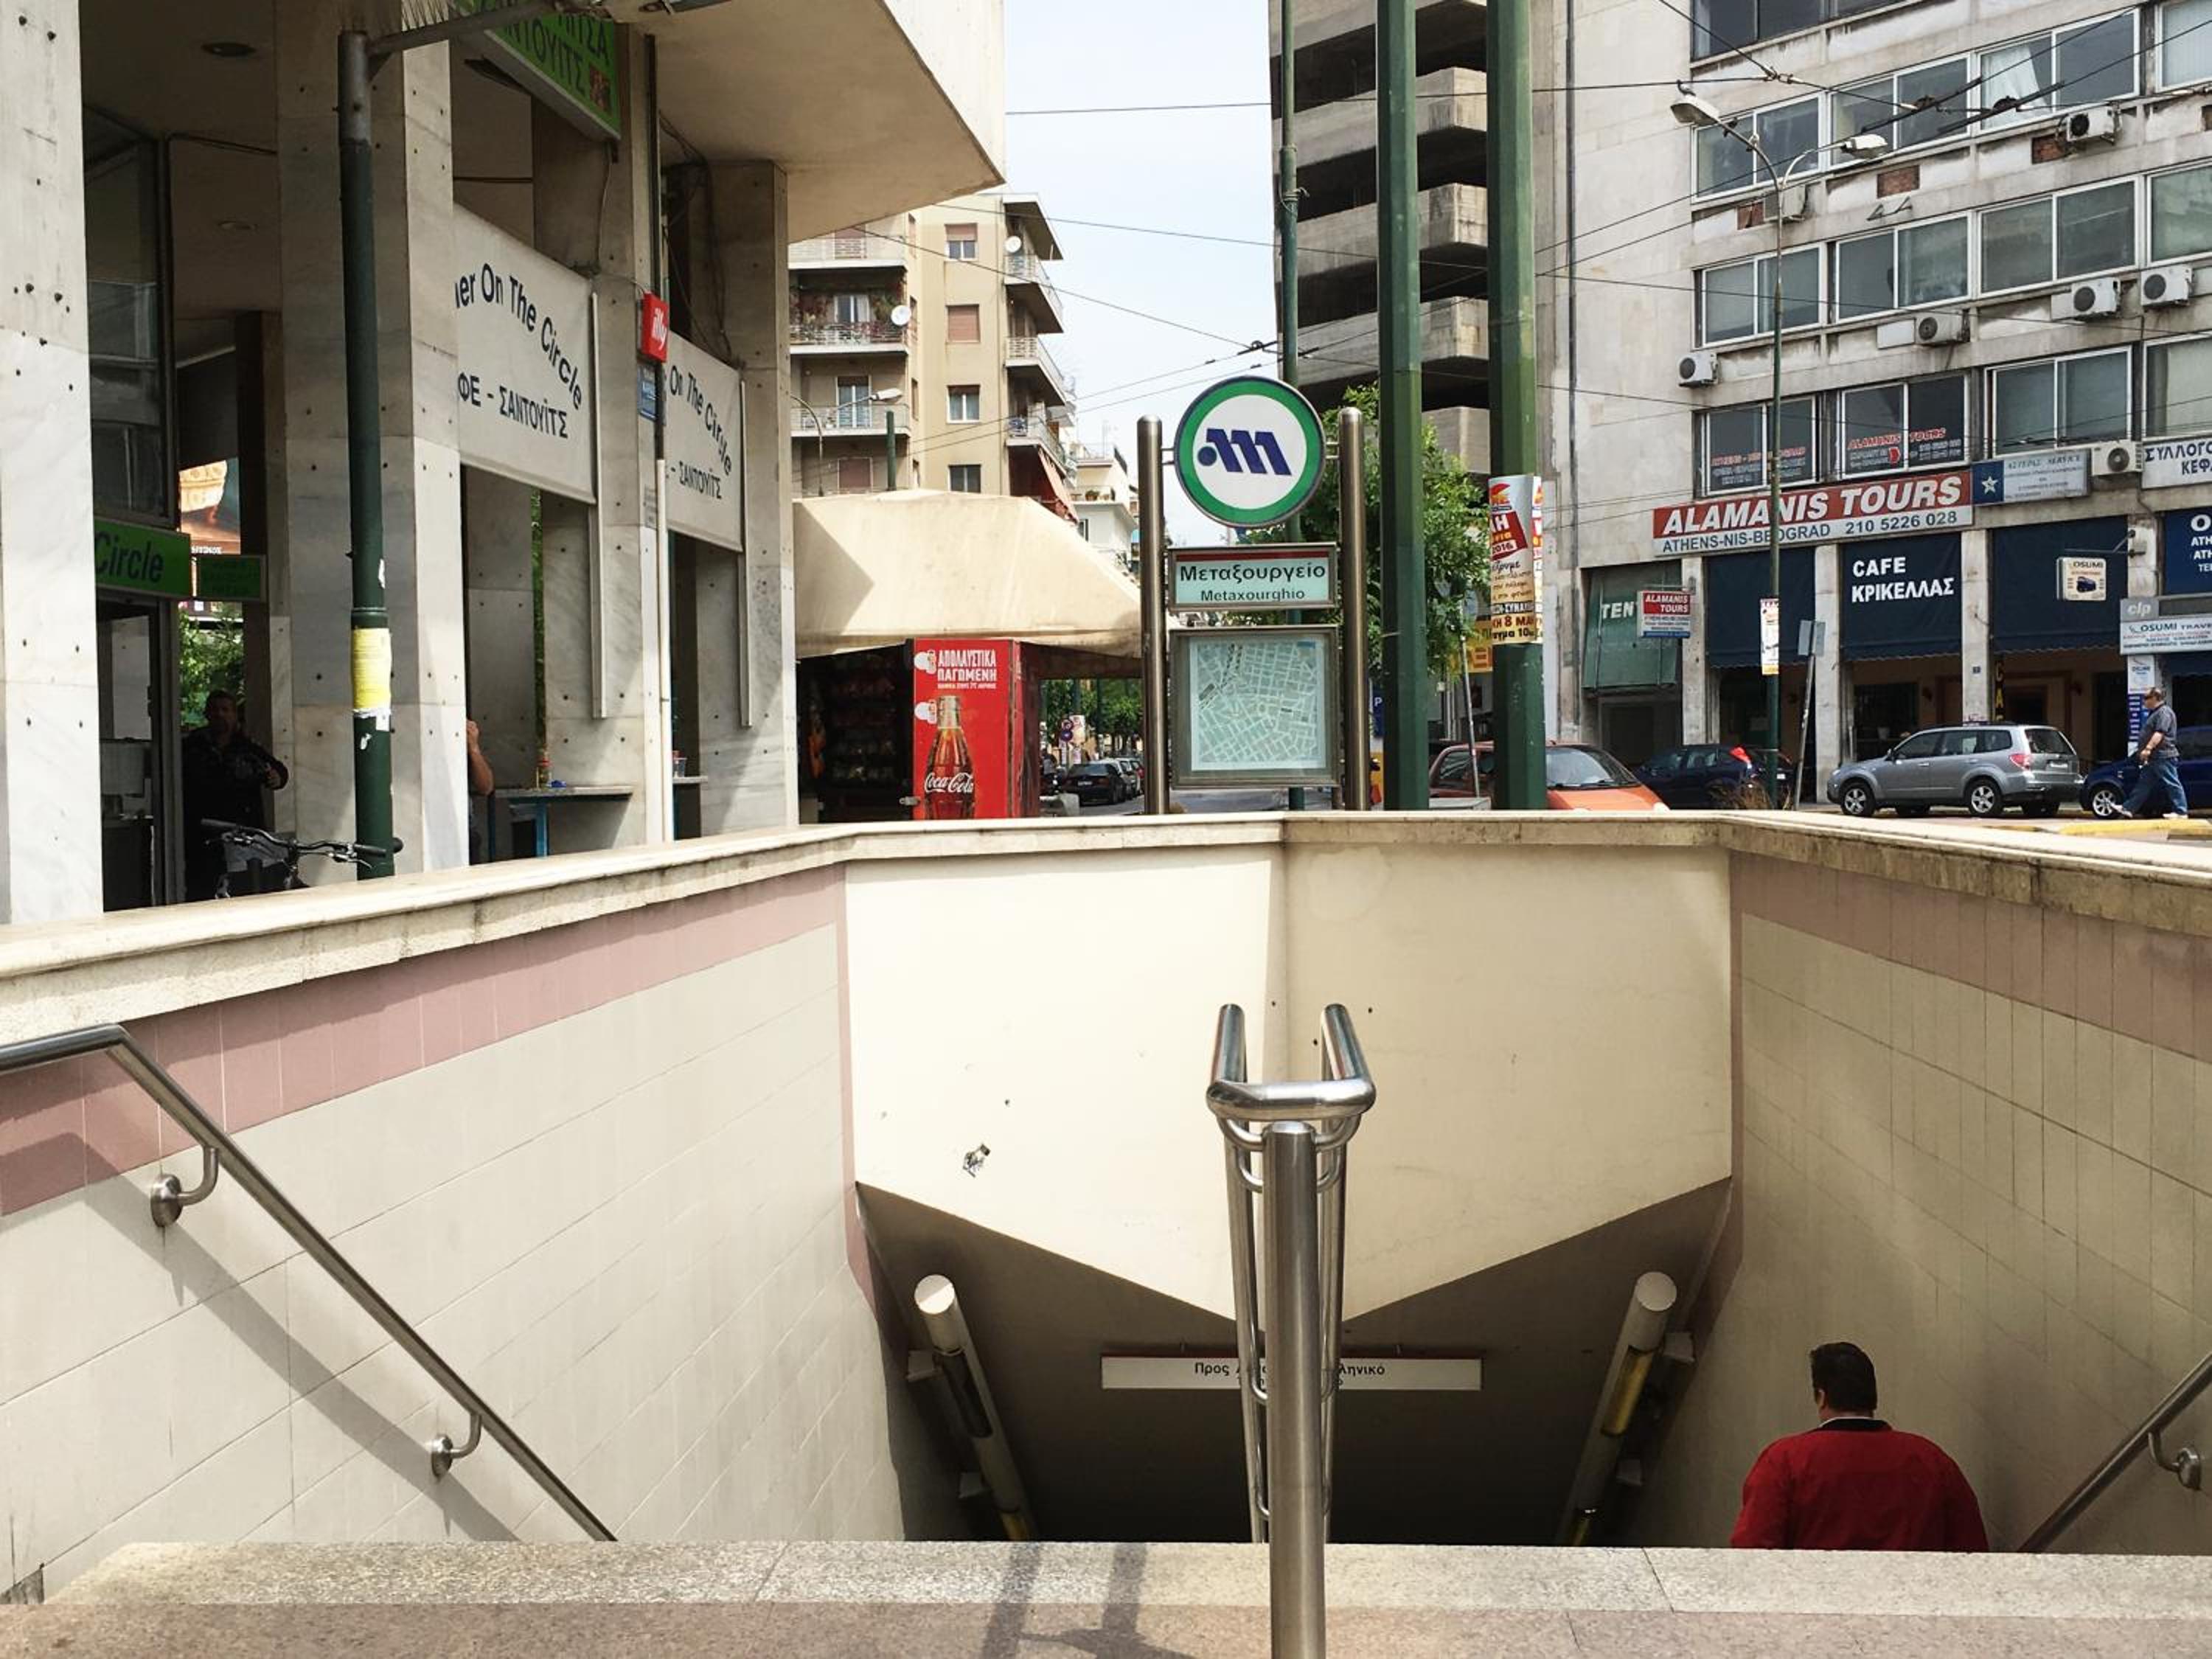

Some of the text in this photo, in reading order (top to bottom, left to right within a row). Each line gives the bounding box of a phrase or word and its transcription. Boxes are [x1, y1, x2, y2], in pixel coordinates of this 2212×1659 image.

[481, 262, 504, 306] On
[509, 275, 537, 333] The
[540, 316, 582, 411] Circle
[2181, 459, 2212, 476] ΚΕΦ
[1663, 475, 1962, 535] ALAMANIS TOURS
[1845, 522, 1874, 535] 210
[1880, 515, 1920, 531] 5226
[1925, 510, 1958, 526] 028
[1180, 563, 1326, 584] Μεταξουργείο
[1853, 557, 1906, 577] CAFE
[1200, 588, 1306, 602] Metaxourghio
[1851, 577, 1955, 602] ΚΡΙΚΕΛΛΑΣ
[1645, 594, 1688, 604] ALAMANIS
[1660, 604, 1688, 613] TOURS
[2140, 623, 2178, 632] OSUMI
[1194, 1362, 1230, 1377] Προς
